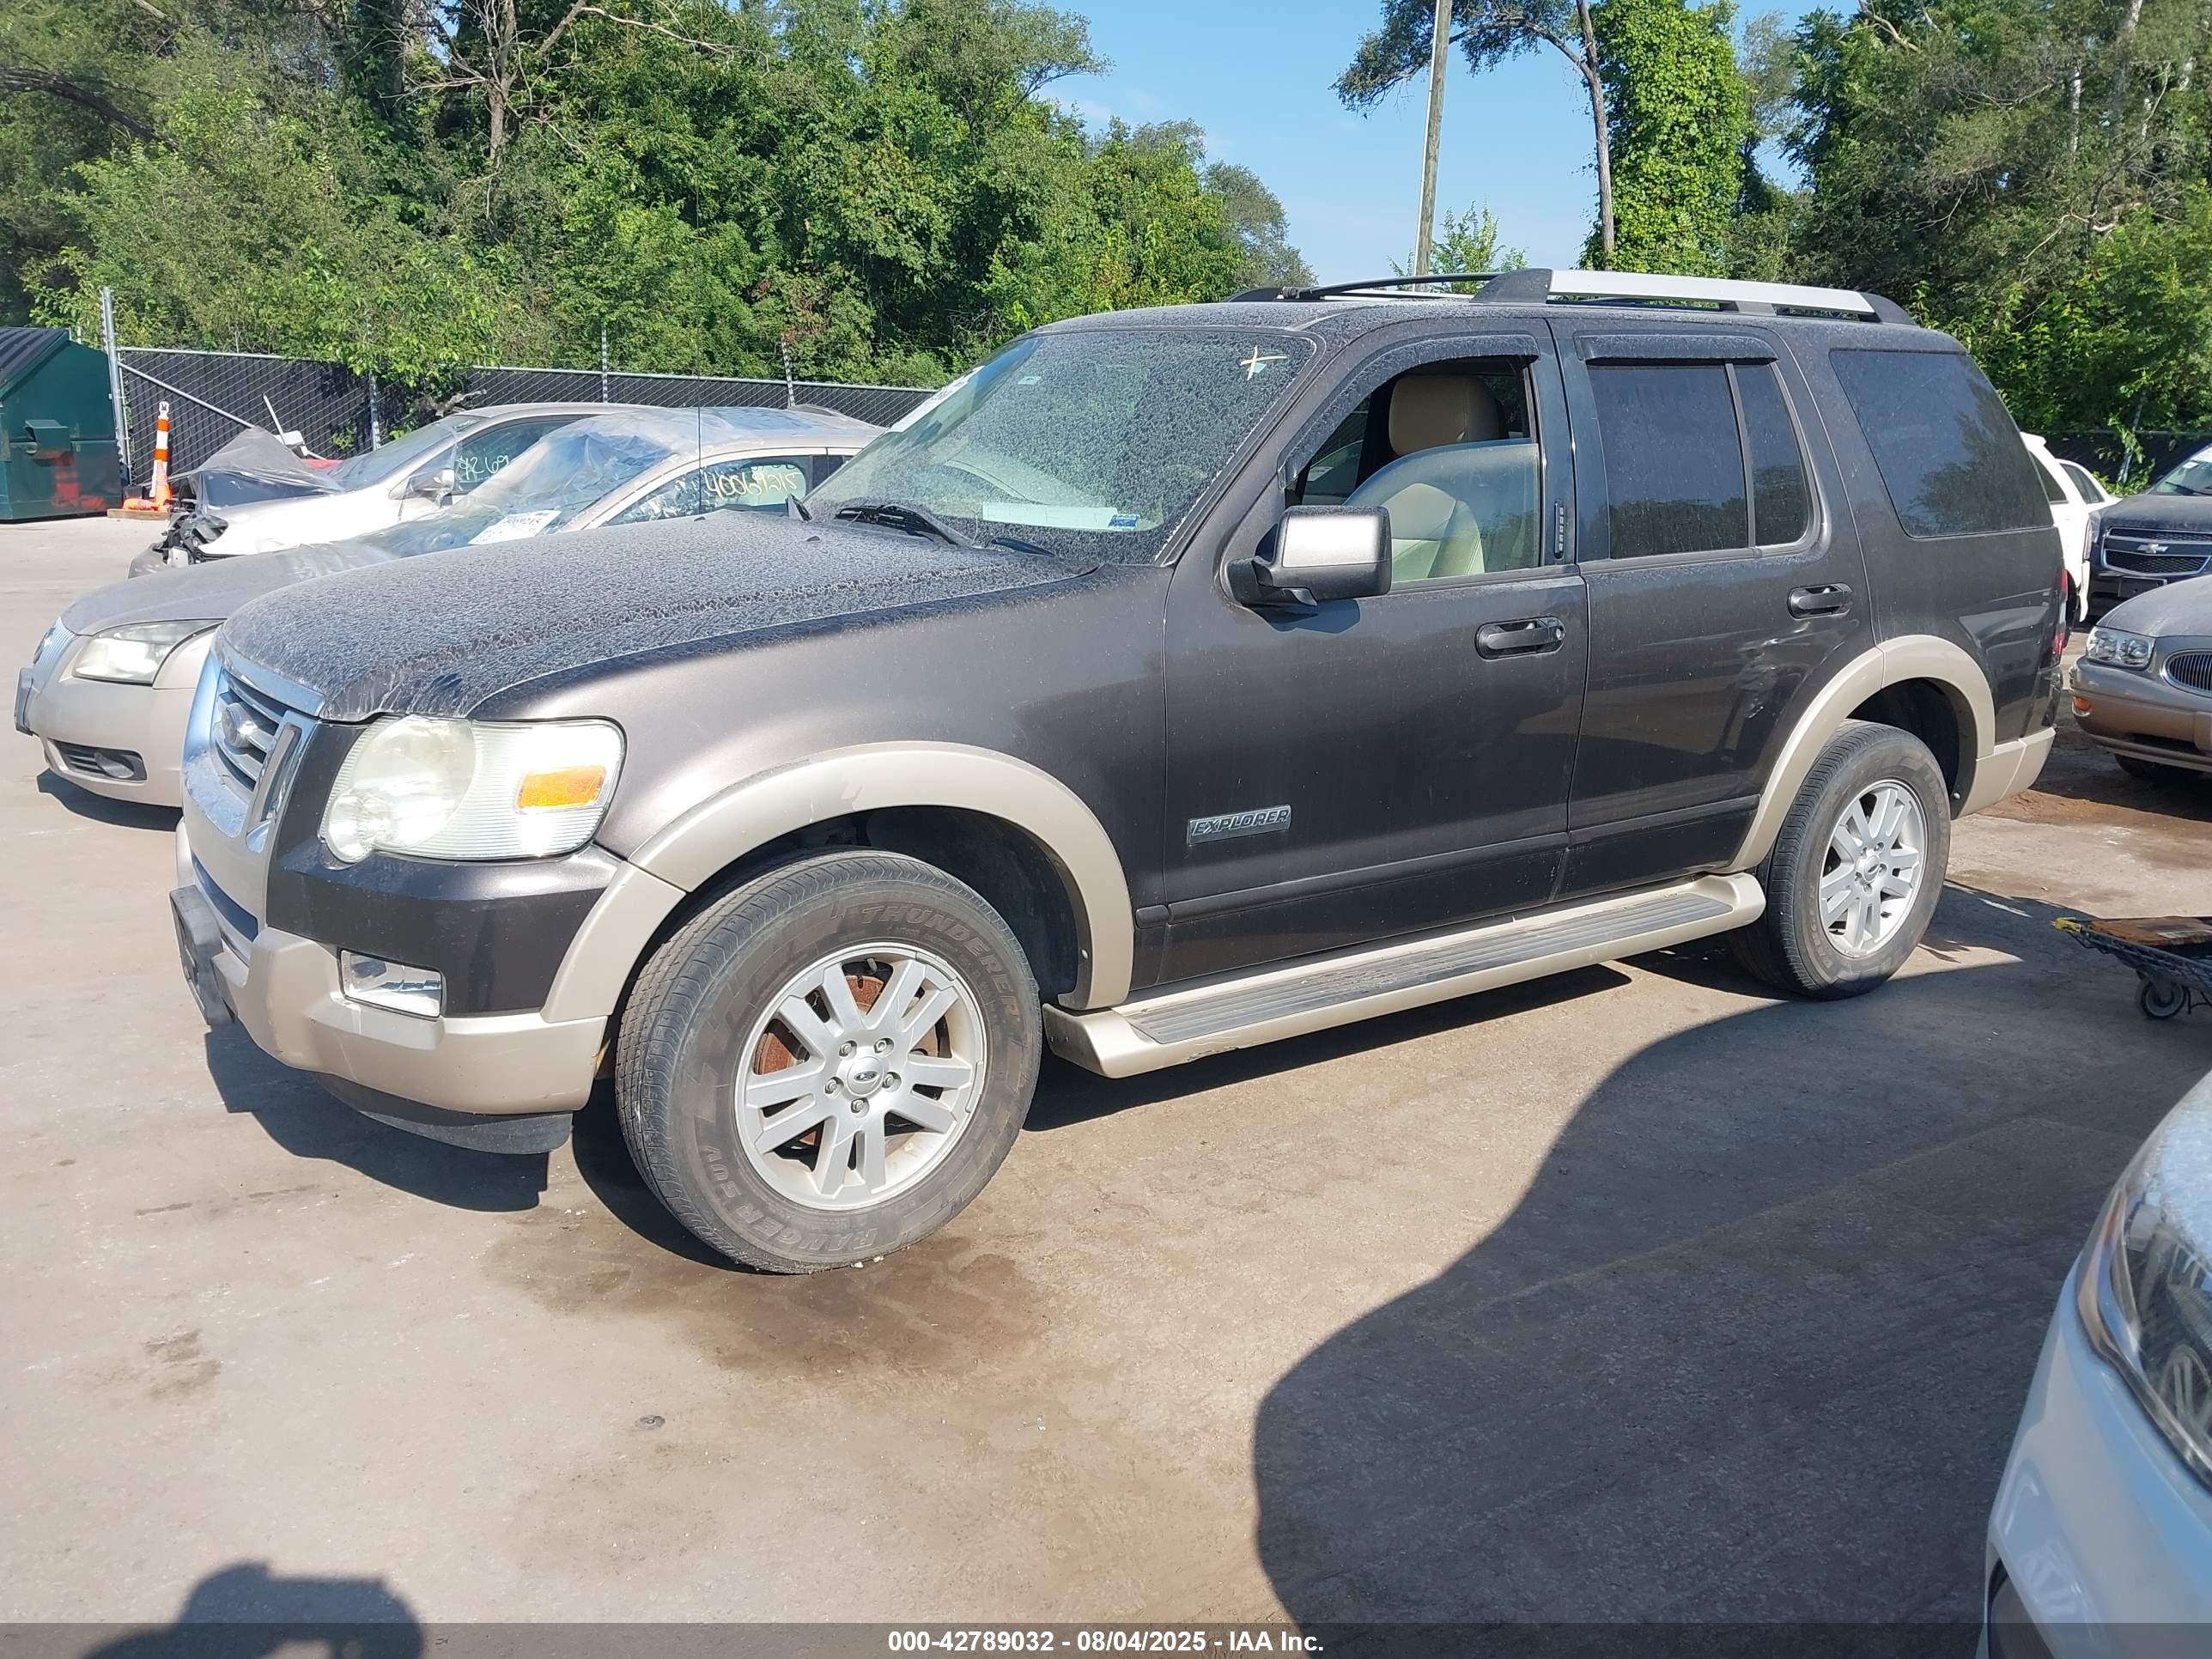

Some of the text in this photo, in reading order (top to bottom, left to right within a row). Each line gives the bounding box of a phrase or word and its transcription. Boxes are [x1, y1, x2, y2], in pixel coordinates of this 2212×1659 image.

[1191, 809, 1290, 836] EXPLORER
[861, 905, 1020, 1017] THUNDERER
[704, 1145, 879, 1251] RANGER SUV
